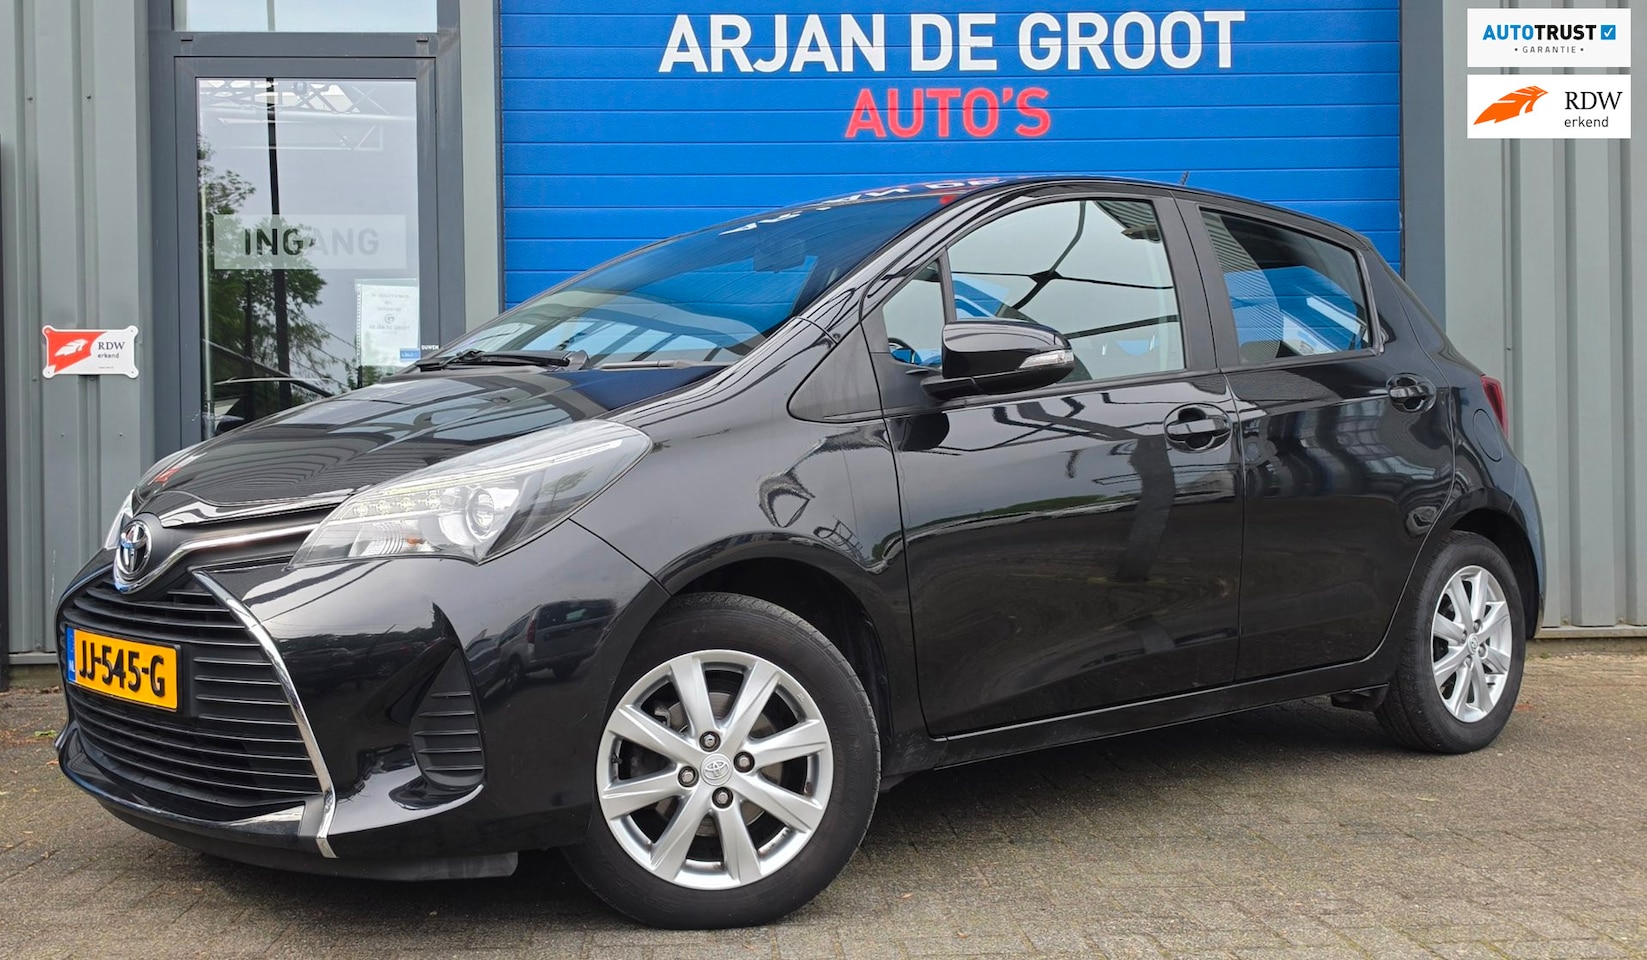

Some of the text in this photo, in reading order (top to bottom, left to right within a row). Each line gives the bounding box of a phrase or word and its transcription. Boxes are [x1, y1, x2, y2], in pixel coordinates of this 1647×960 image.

[658, 11, 1245, 72] ARJAN DE GROOT
[845, 87, 1051, 138] AUTO'S
[244, 227, 380, 256] INGANG
[97, 341, 126, 350] RDW
[79, 640, 166, 698] JJ-545-G
